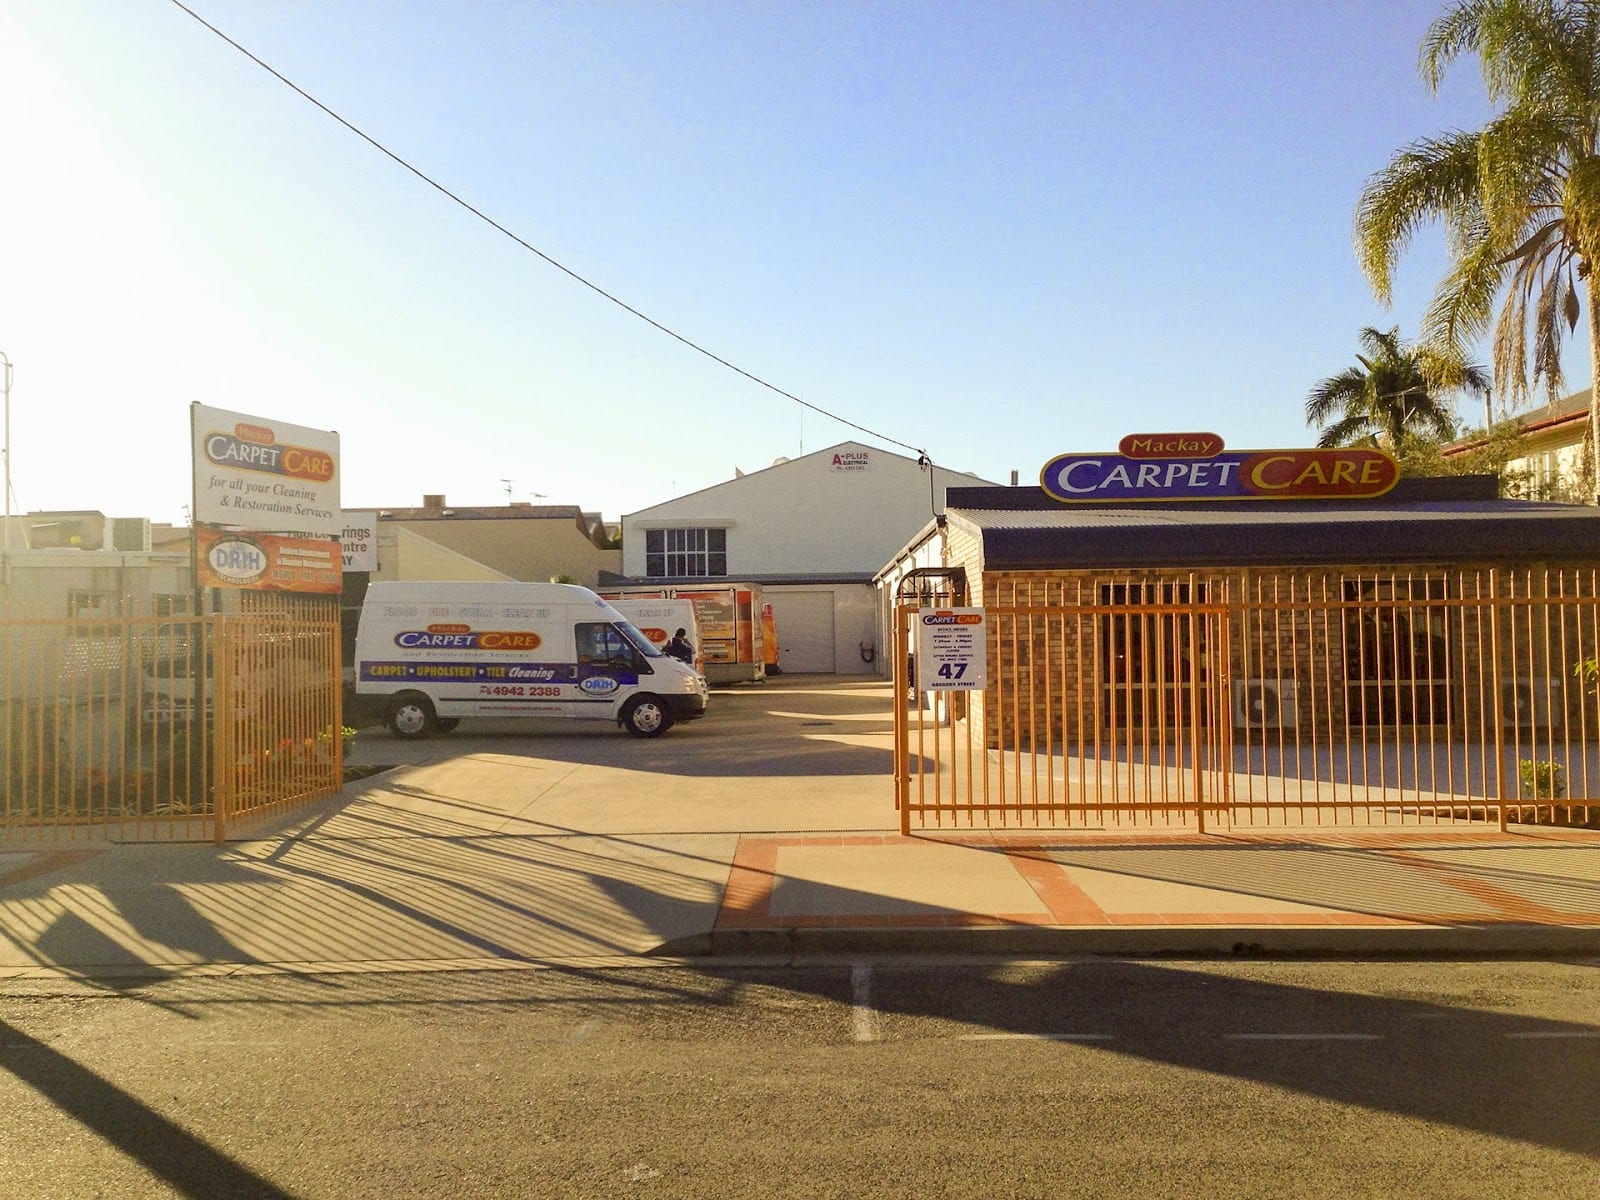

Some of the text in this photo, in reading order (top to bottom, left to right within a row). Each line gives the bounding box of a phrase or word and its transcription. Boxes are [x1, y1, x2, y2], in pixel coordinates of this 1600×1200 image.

[1131, 438, 1213, 454] Mackay
[207, 436, 329, 475] CARPET CARE
[832, 452, 869, 465] A-PLUS
[1057, 456, 1384, 493] CARPET CARE
[208, 475, 316, 501] for all your Cleaning
[220, 494, 334, 519] & Restoration Services
[924, 616, 955, 624] CARPET
[399, 633, 535, 647] CARPET CARE
[370, 666, 555, 680] CARPET UPHOLSTERY TILE Cleaning
[938, 663, 968, 680] 47
[493, 686, 524, 695] 4942
[529, 686, 561, 696] 2388
